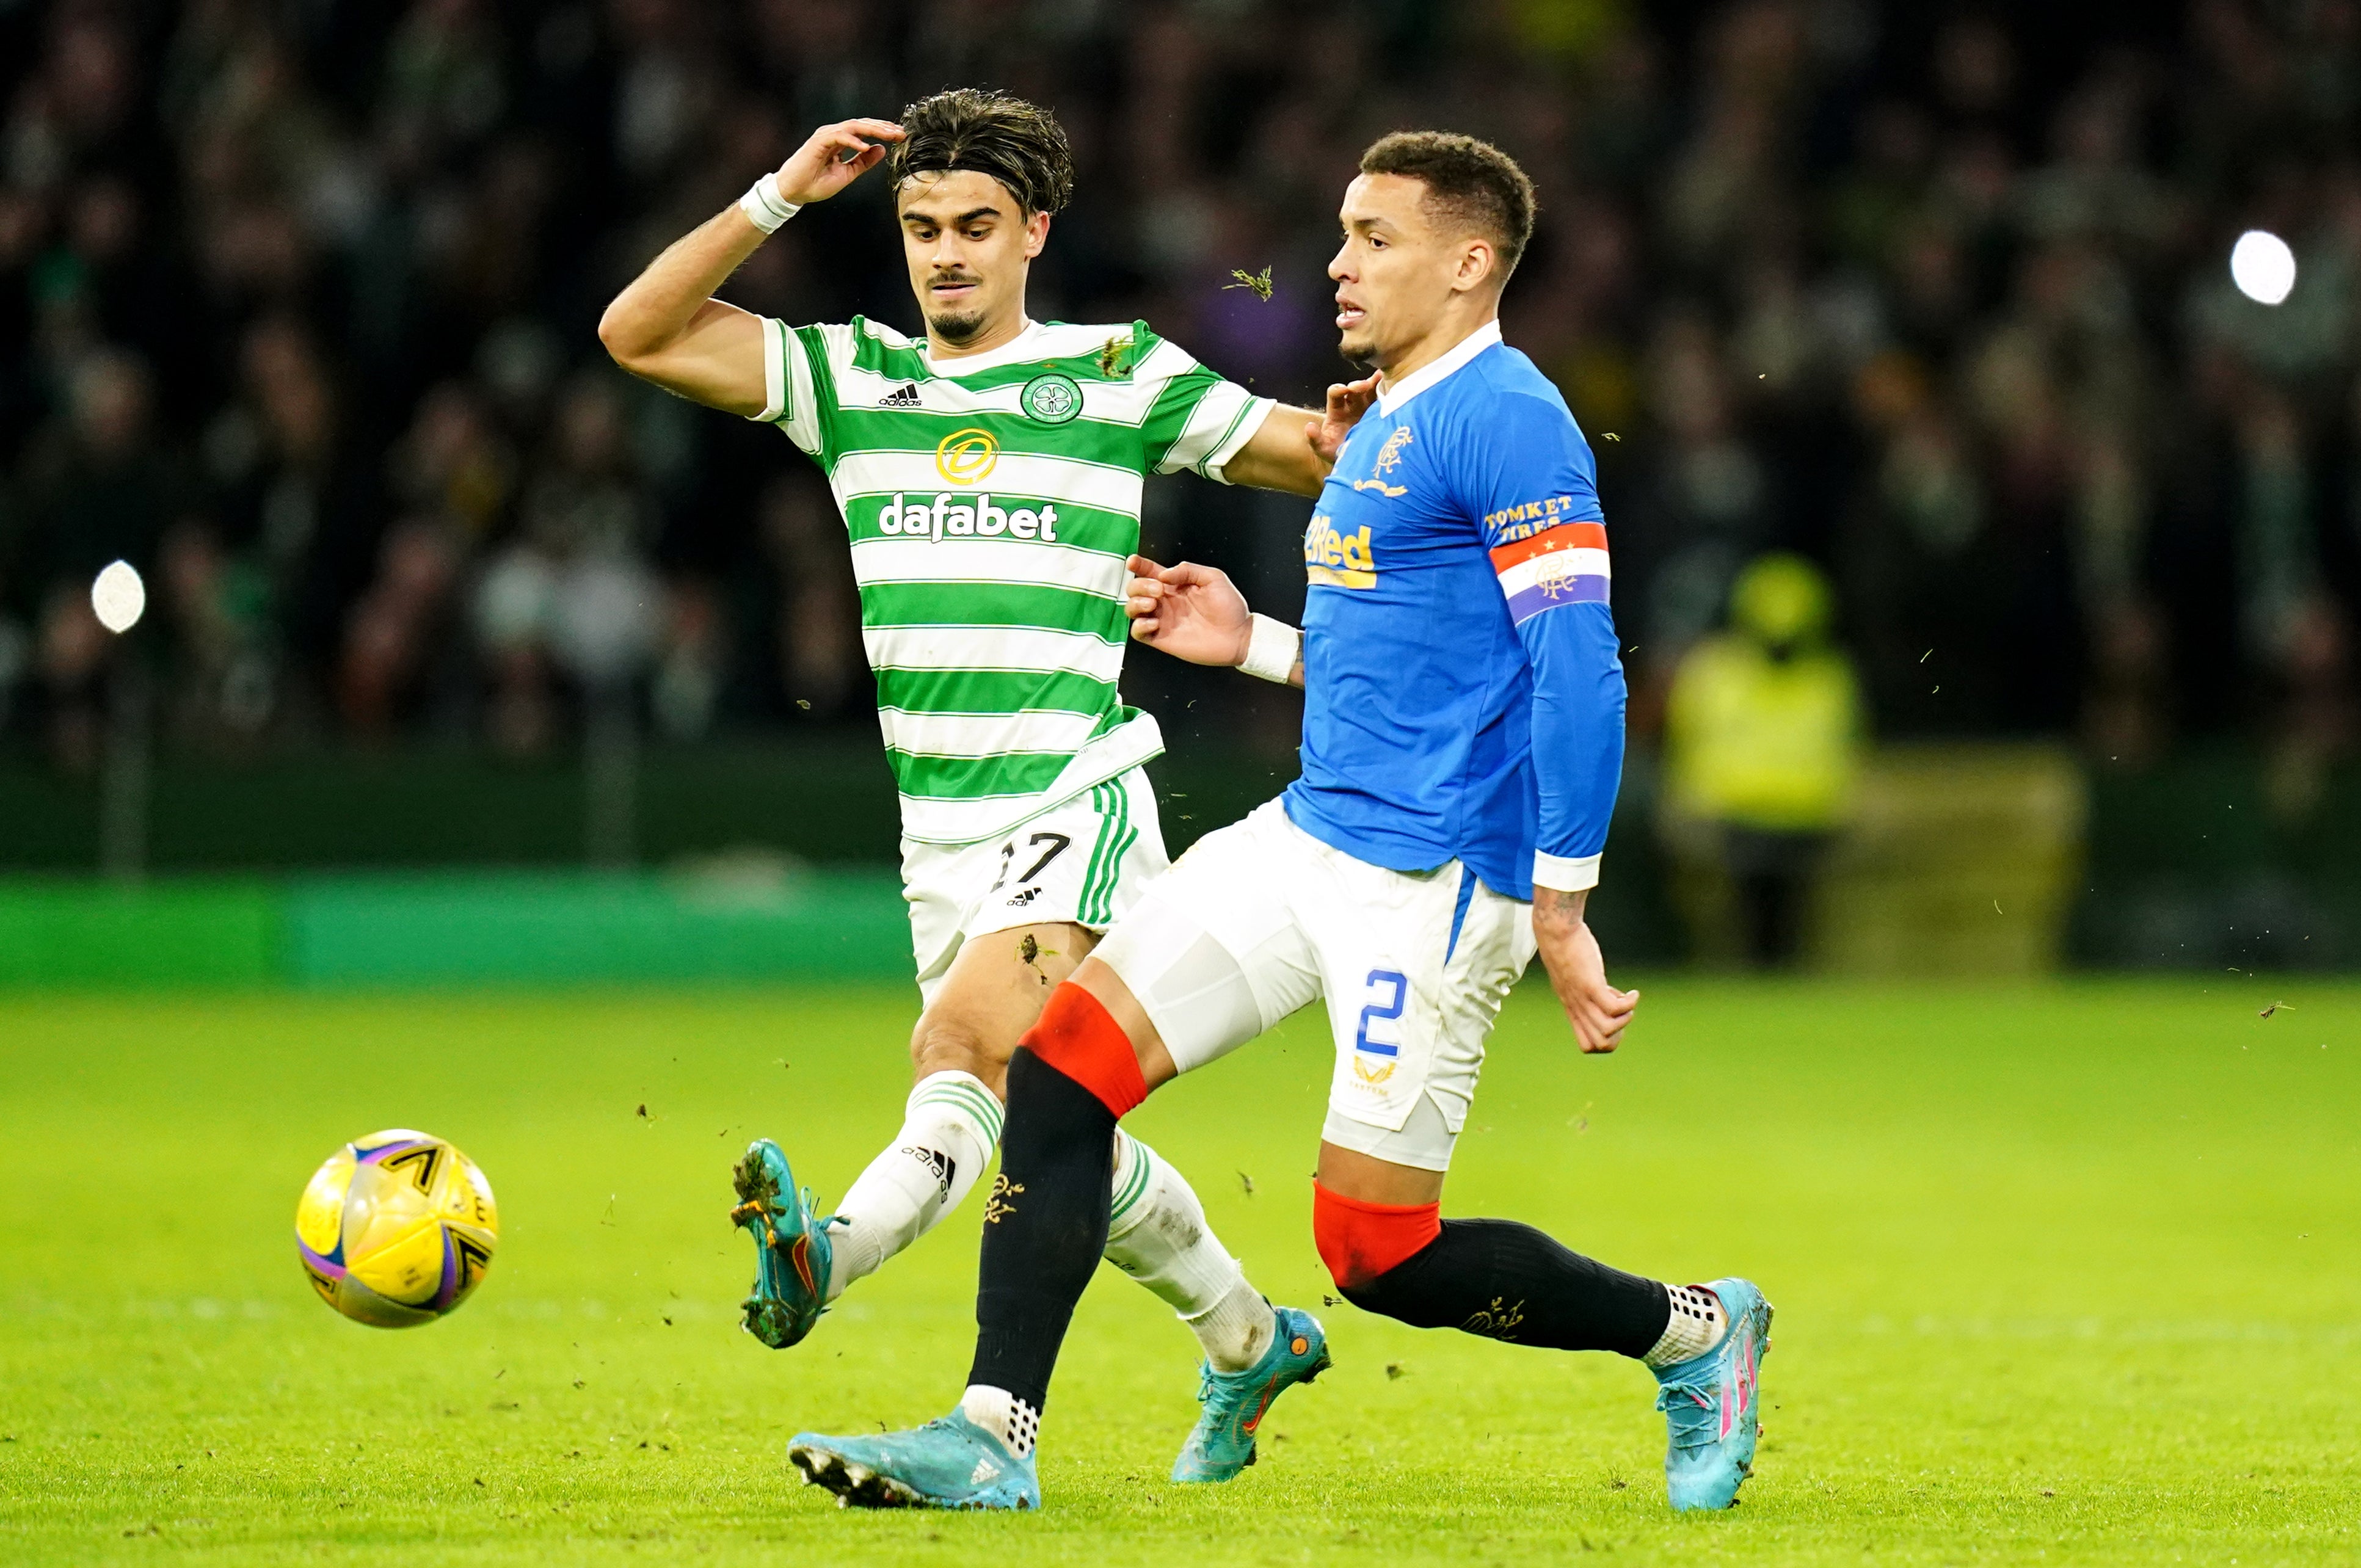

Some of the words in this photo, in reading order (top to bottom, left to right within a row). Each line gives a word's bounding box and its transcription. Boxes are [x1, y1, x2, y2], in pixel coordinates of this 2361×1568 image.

[879, 398, 922, 407] adidas
[878, 492, 1058, 543] dafabet
[1484, 496, 1572, 530] TOMKET
[1499, 515, 1561, 542] TIRES
[990, 831, 1073, 894] 17
[1356, 969, 1408, 1057] 2
[901, 1147, 948, 1204] adidas
